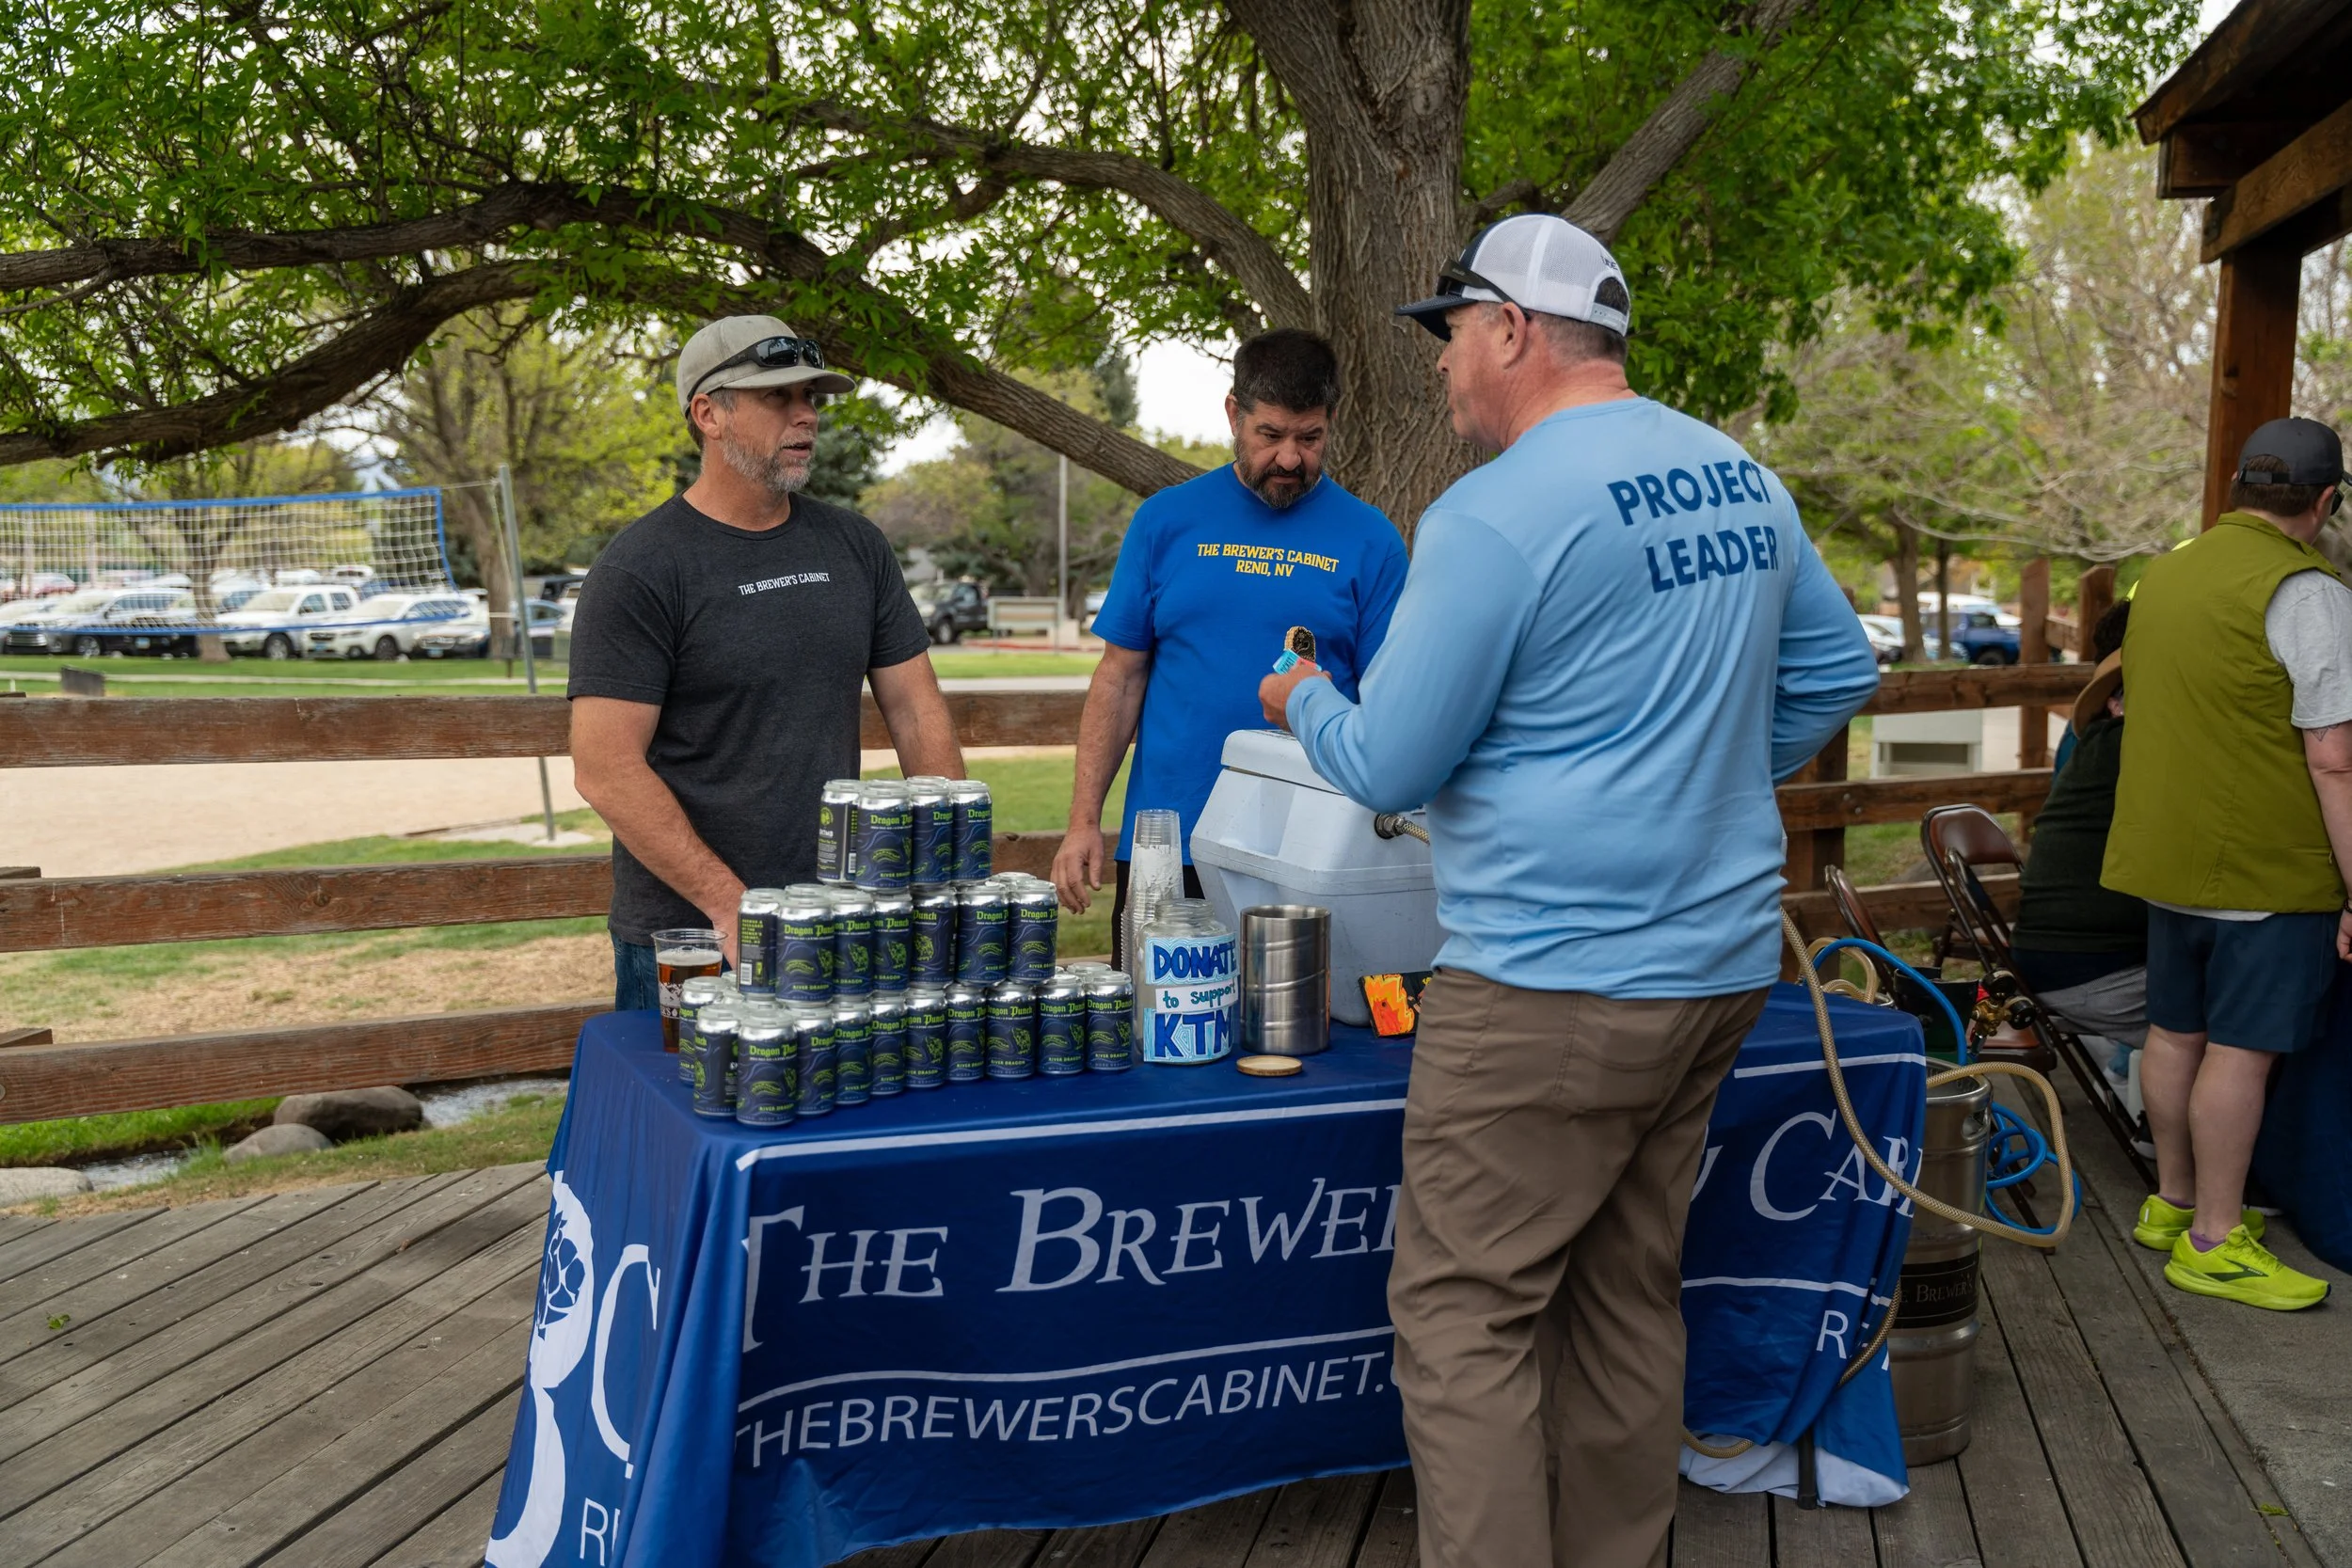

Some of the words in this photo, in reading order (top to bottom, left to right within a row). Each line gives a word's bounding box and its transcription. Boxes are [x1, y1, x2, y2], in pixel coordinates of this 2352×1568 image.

[1606, 459, 1772, 527] PROJECT
[1197, 544, 1221, 557] THE
[1222, 544, 1285, 561] BREWER'S
[1286, 549, 1340, 573] CABINET
[1645, 526, 1779, 594] LEADER
[1235, 560, 1271, 577] RENO,
[1274, 563, 1295, 578] NV
[738, 583, 756, 595] THE
[755, 575, 799, 592] BREWER'S
[798, 572, 831, 584] CABINET
[870, 815, 899, 826] Dragon
[976, 911, 1003, 921] Dragon
[1021, 909, 1048, 919] Dragon
[847, 920, 871, 932] Punch
[885, 918, 909, 929] Punch
[784, 925, 814, 936] Dragon
[1088, 999, 1112, 1010] Dragon
[1162, 990, 1180, 1008] to
[947, 1008, 975, 1019] Dragon
[1009, 1006, 1033, 1017] Punch
[1040, 1003, 1066, 1014] Dragon
[872, 1020, 899, 1031] Dragon
[834, 1028, 864, 1039] Dragon
[749, 1045, 781, 1057] Dragon
